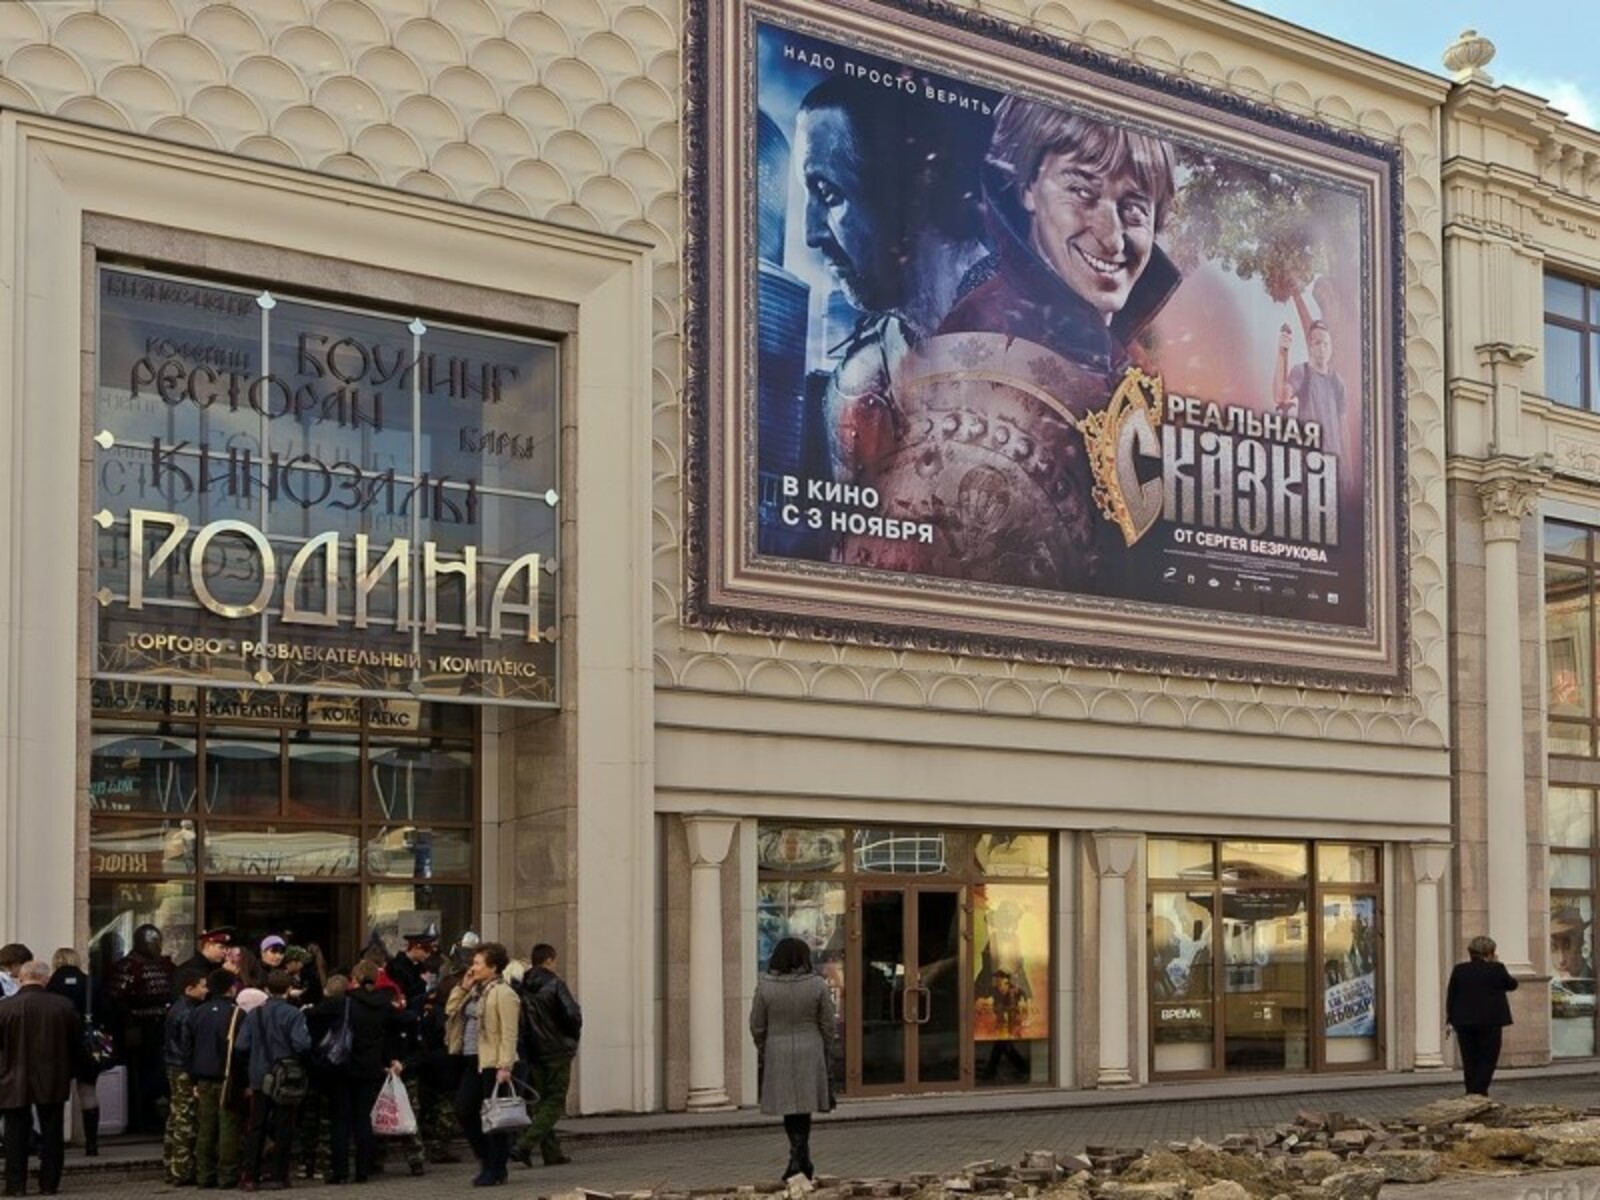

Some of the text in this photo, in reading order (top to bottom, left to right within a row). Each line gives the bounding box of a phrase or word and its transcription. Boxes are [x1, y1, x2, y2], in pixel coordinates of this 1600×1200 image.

[784, 46, 991, 115] НАДО ПРОСТО ВЕРИТЬ
[131, 357, 384, 433] РЕСТОРАН
[297, 331, 520, 404] БОУЛИНГ
[1167, 394, 1321, 448] РЕАЛЬНАЯ
[151, 437, 478, 525] КИНОЗАЛЫ
[783, 475, 879, 508] В КИНО
[782, 504, 933, 544] С 3 НОЯБРЯ
[1174, 528, 1328, 563] ОТ СЕРГЕЯ БЕЗРУКОВА
[127, 508, 541, 643] РОДИНА
[127, 631, 222, 655] ТОРГОВО
[242, 641, 422, 669] РАЗВЛЕКАТЕЛЬНЫЙ
[439, 656, 537, 678] КОМПЛЕКС
